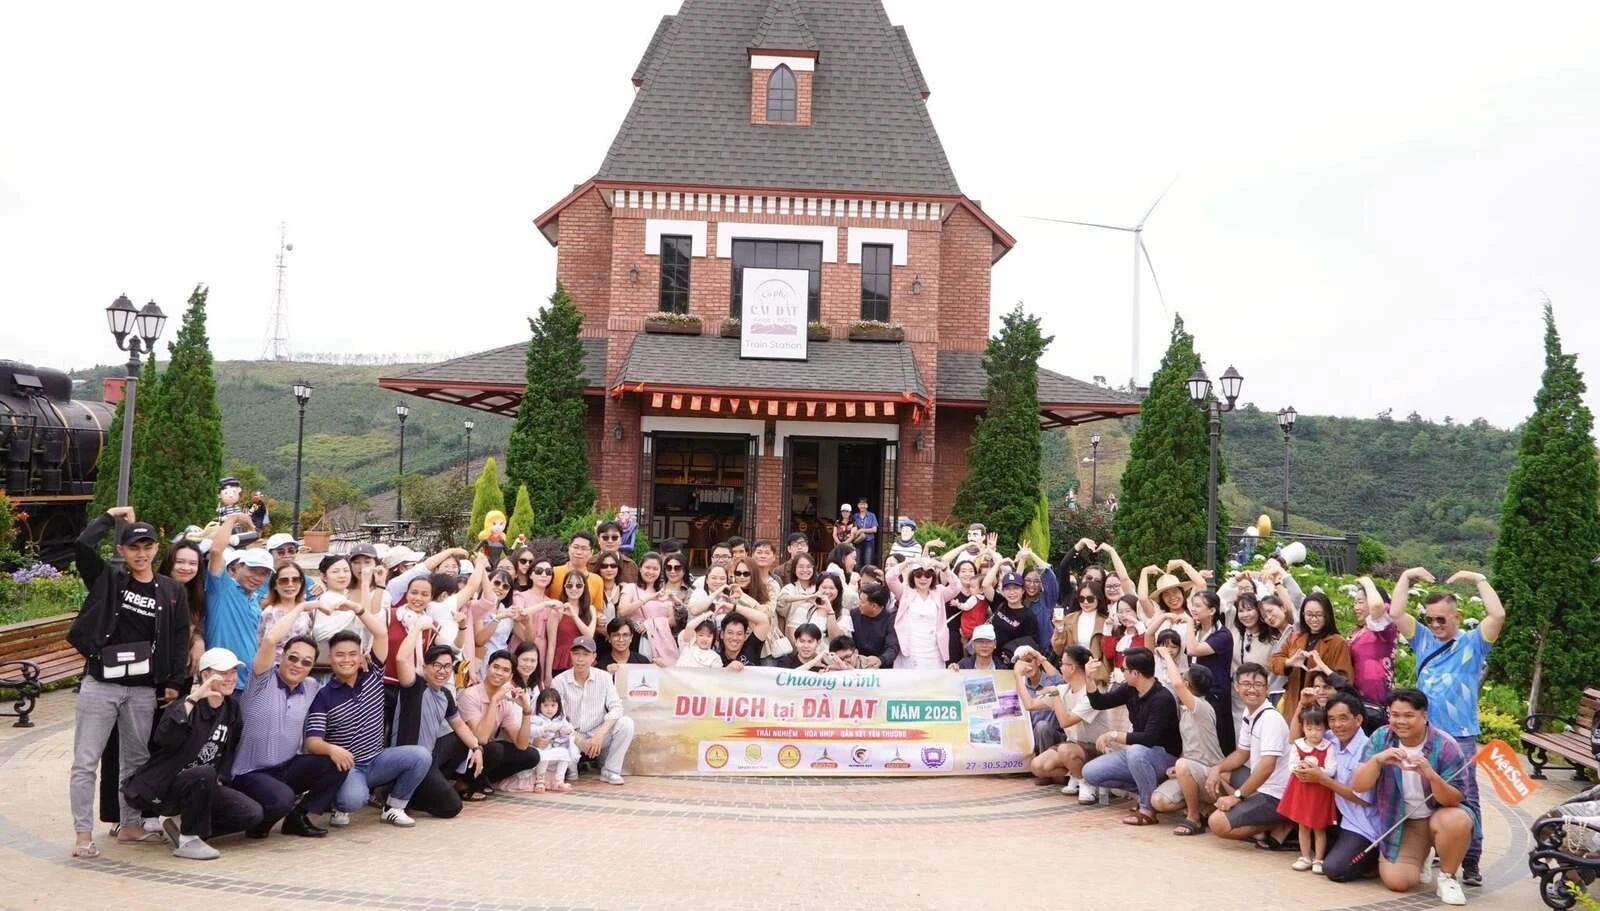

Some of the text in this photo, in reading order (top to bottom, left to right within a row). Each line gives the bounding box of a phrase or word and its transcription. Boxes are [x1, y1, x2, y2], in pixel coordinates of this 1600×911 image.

[745, 340, 802, 350] Train Station
[775, 671, 880, 690] Chương trình
[675, 694, 958, 722] DU LỊCH tại ĐÀ LẠT NĂM 2026
[965, 762, 977, 770] 27
[983, 760, 1024, 770] 30.5.2026
